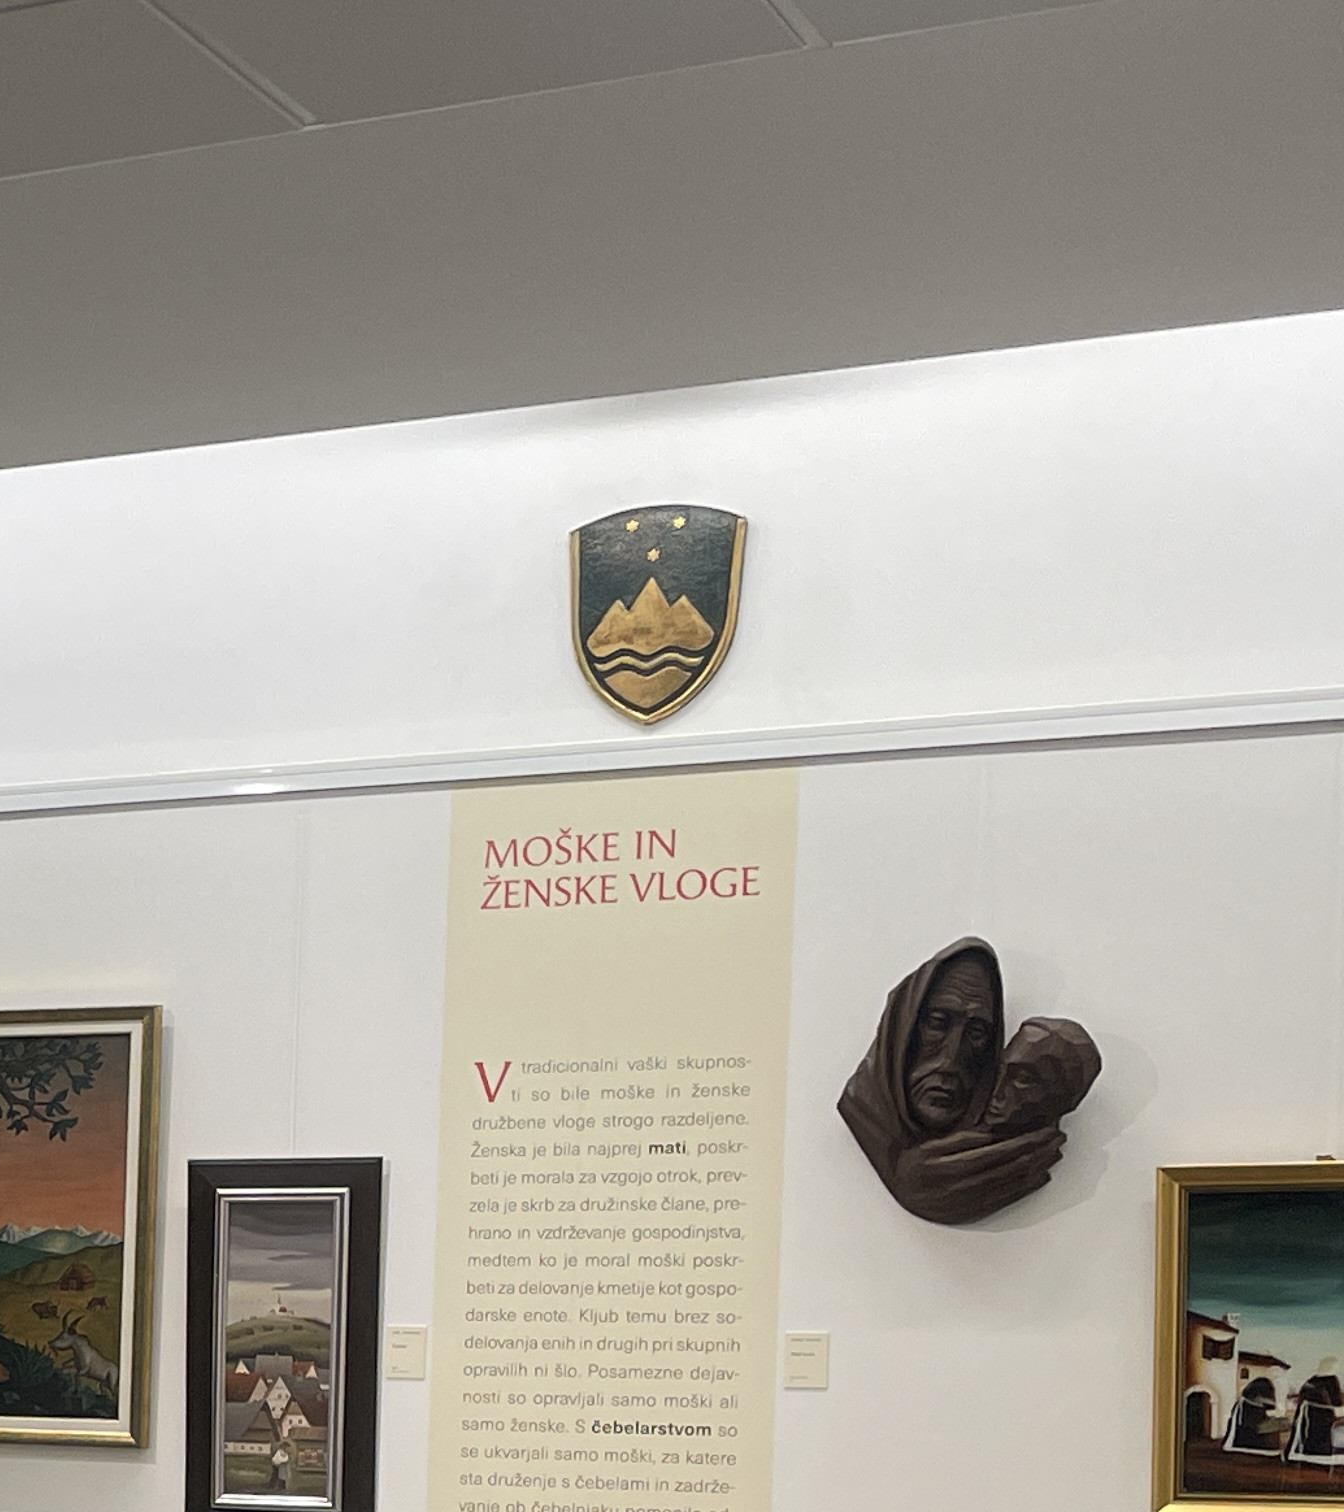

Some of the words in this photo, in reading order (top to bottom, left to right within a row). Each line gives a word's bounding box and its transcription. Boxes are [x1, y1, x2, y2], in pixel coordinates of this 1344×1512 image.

[484, 827, 621, 869] MOŠKE
[635, 828, 678, 861] IN
[480, 874, 619, 910] ŽENSKE
[629, 866, 761, 902] VLOGE
[475, 1061, 512, 1103] V
[521, 1059, 618, 1074] tradicionalni
[627, 1057, 667, 1071] vaški
[677, 1056, 751, 1072] skupnos-
[511, 1090, 520, 1102] ti
[531, 1090, 550, 1102] so
[561, 1086, 590, 1101] bile
[601, 1085, 655, 1100] moške
[666, 1086, 680, 1098] in
[691, 1082, 750, 1098] ženske
[472, 1116, 546, 1130] družbene
[553, 1114, 595, 1132] vloge
[602, 1115, 654, 1131] strogo
[471, 1140, 526, 1158] Ženska
[532, 1145, 547, 1160] je
[553, 1142, 580, 1156] bila
[587, 1144, 641, 1159] najprej
[697, 1139, 748, 1157] poskr-
[471, 1171, 499, 1185] beti
[502, 1171, 517, 1188] je
[521, 1170, 574, 1184] morala
[578, 1173, 596, 1184] za
[601, 1170, 653, 1187] vzgojo
[706, 1171, 747, 1185] prev-
[469, 1198, 500, 1213] zela
[503, 1198, 517, 1215] je
[521, 1198, 555, 1212] skrb
[558, 1201, 576, 1212] za
[580, 1196, 657, 1212] družinske
[713, 1199, 746, 1214] pre-
[468, 1226, 512, 1240] hrano
[517, 1228, 531, 1239] in
[536, 1225, 626, 1243] vzdrževanje
[468, 1253, 531, 1267] medtem
[539, 1253, 557, 1267] ko
[563, 1253, 578, 1270] je
[585, 1253, 630, 1267] moral
[638, 1253, 685, 1267] moški
[693, 1253, 744, 1270] poskr-
[467, 1280, 495, 1295] beti
[498, 1283, 515, 1295] za
[519, 1281, 594, 1298] delovanje
[597, 1280, 655, 1299] kmetije
[659, 1281, 682, 1295] kot
[685, 1284, 742, 1299] gospo-
[465, 1308, 517, 1322] darske
[579, 1308, 619, 1326] Kljub
[626, 1310, 666, 1323] temu
[674, 1309, 710, 1324] brez
[716, 1313, 742, 1324] so-
[464, 1335, 538, 1353] delovanja
[541, 1336, 575, 1350] enih
[579, 1339, 593, 1350] in
[596, 1336, 648, 1354] drugih
[652, 1337, 673, 1355] pri
[676, 1337, 740, 1355] skupnih
[463, 1362, 528, 1379] opravilih
[534, 1364, 548, 1377] ni
[588, 1363, 683, 1380] Posamezne
[690, 1365, 740, 1384] dejav-
[463, 1390, 501, 1404] nosti
[507, 1393, 526, 1405] so
[533, 1391, 604, 1410] opravljali
[611, 1396, 657, 1408] samo
[664, 1393, 712, 1409] moški
[719, 1395, 738, 1409] ali
[462, 1420, 505, 1431] samo
[575, 1418, 586, 1434] S
[591, 1419, 712, 1437] čebelarstvom
[718, 1426, 738, 1437] so
[461, 1447, 479, 1458] se
[484, 1445, 548, 1463] ukvarjali
[554, 1449, 599, 1462] samo
[661, 1452, 680, 1464] za
[686, 1450, 736, 1466] katere
[460, 1473, 482, 1485] sta
[487, 1472, 556, 1491] druženje
[562, 1478, 570, 1489] s
[575, 1475, 650, 1491] čebelami
[655, 1478, 669, 1492] in
[674, 1479, 735, 1494] zadrže-
